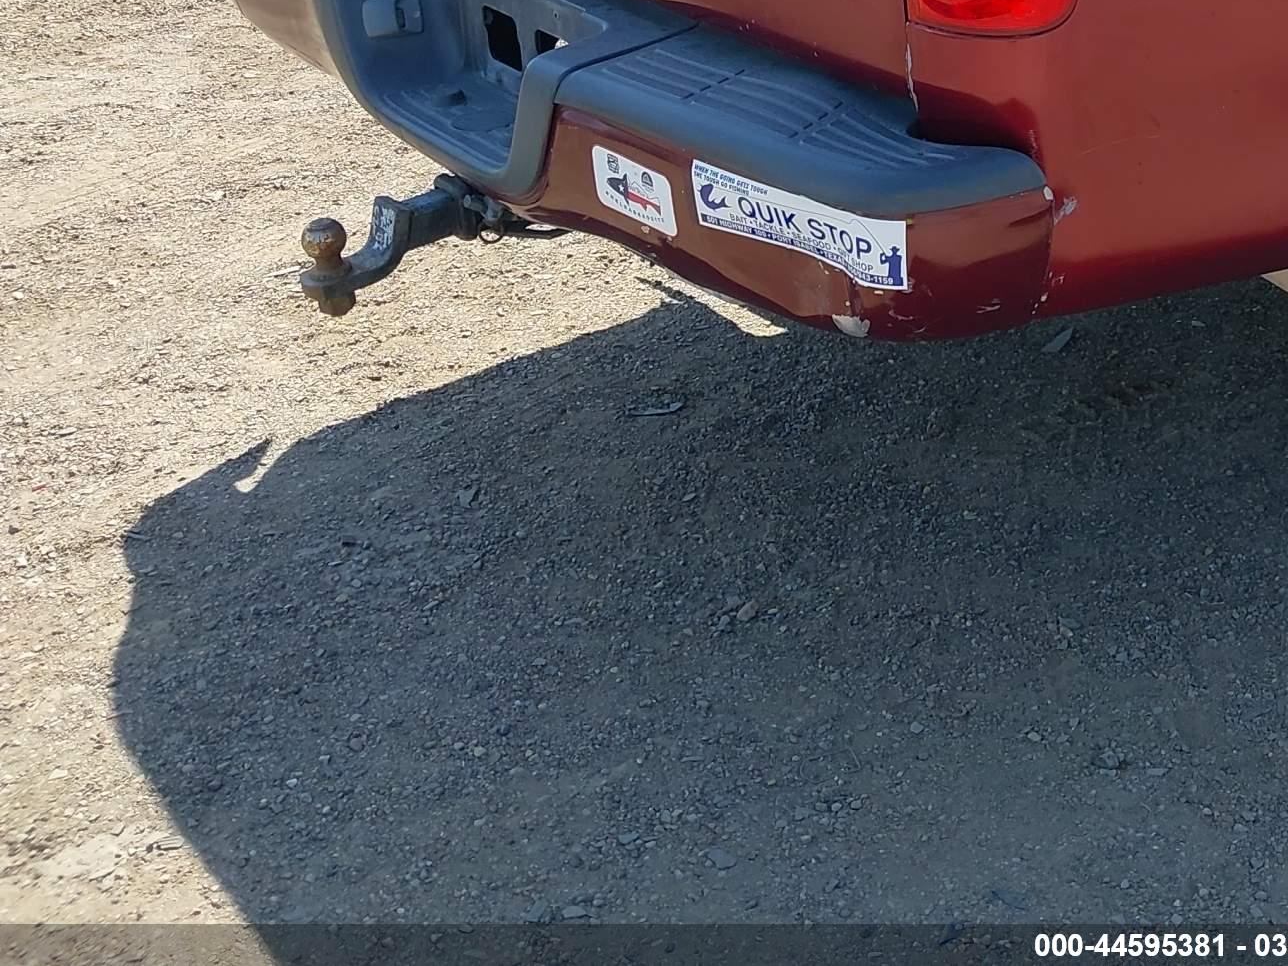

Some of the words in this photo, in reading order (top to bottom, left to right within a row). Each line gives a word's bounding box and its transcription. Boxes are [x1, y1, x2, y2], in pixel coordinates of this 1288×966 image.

[737, 196, 802, 233] QUIK
[807, 217, 873, 260] STOP
[755, 219, 786, 235] TACKLE
[791, 231, 831, 251] SEAFOOD
